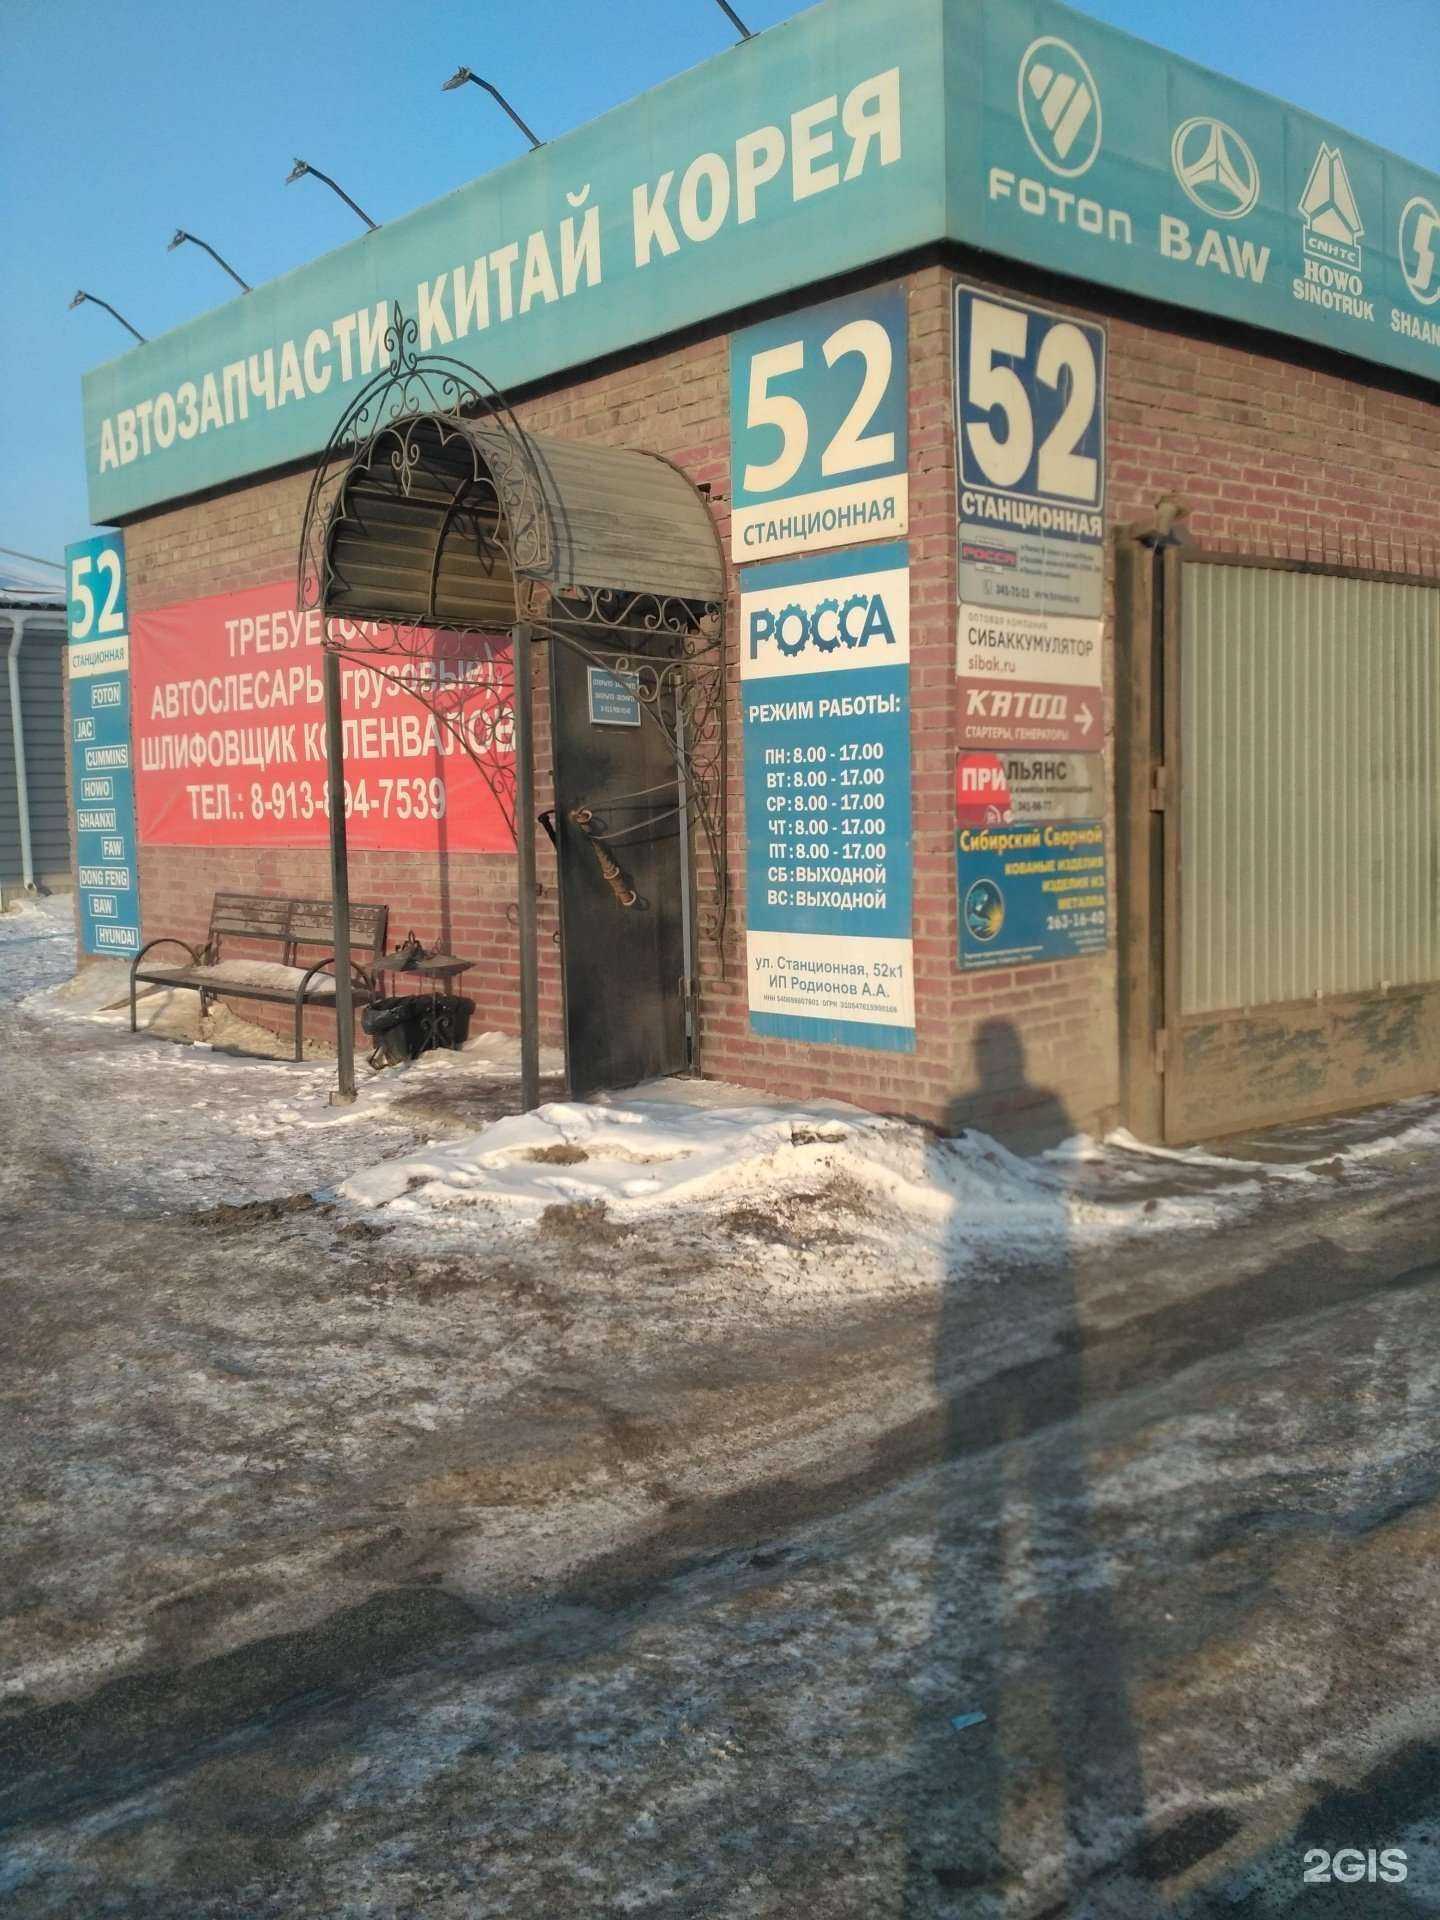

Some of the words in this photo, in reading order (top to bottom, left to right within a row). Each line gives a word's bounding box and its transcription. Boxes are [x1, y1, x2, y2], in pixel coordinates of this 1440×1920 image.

[989, 167, 1132, 244] FOTON
[1160, 214, 1271, 284] BAW
[1309, 238, 1356, 262] CNHTC
[99, 300, 391, 474] АВТОЗАПЧАСТИ
[417, 184, 602, 350] КИТАЙ
[633, 66, 902, 267] КОРЕЯ
[1304, 258, 1363, 296] HOWO
[1292, 278, 1375, 322] SINOTRUK
[743, 319, 895, 493] 52
[966, 298, 1098, 501] 52
[743, 496, 895, 546] СТАНЦИОННАЯ
[961, 491, 1103, 538] СТАНЦИОННАЯ
[72, 549, 124, 639] 52
[750, 592, 896, 659] РОССА
[968, 627, 1093, 657] СИБАККУМУЛЯТОР
[72, 647, 124, 669] СТАНЦИОННАЯ
[92, 686, 120, 705] FOTON
[151, 665, 324, 720] АВТОСЛЕСАРЬ
[966, 689, 1068, 720] КАТОД
[749, 701, 814, 724] РЕЖИМ
[819, 693, 900, 719] РАБОТЫ:
[77, 721, 92, 738] JAC
[87, 748, 127, 767] CUMMINS
[141, 724, 297, 771] ШЛИФОВЩИК
[839, 742, 884, 761] 17.00
[840, 768, 885, 786] 17.00
[1007, 761, 1066, 780] ЛЬЯНС
[84, 781, 109, 798] HOWO
[187, 784, 243, 820] ТЕЛ.:
[840, 793, 885, 811] 17.00
[80, 812, 114, 828] SHAANXI
[841, 818, 886, 835] 17.00
[104, 840, 122, 857] FAW
[842, 843, 886, 860] 17.00
[960, 828, 1041, 856] Сибирский
[81, 869, 104, 886] DONG
[105, 871, 127, 886] FENG
[93, 898, 112, 915] BAW
[99, 927, 135, 945] HYUNDAI
[755, 956, 774, 970] ул.
[777, 956, 869, 978] Станционная,
[873, 963, 903, 978] 52к1
[769, 975, 787, 989] ИП
[791, 976, 857, 995] Родионов
[862, 982, 890, 998] А.А.
